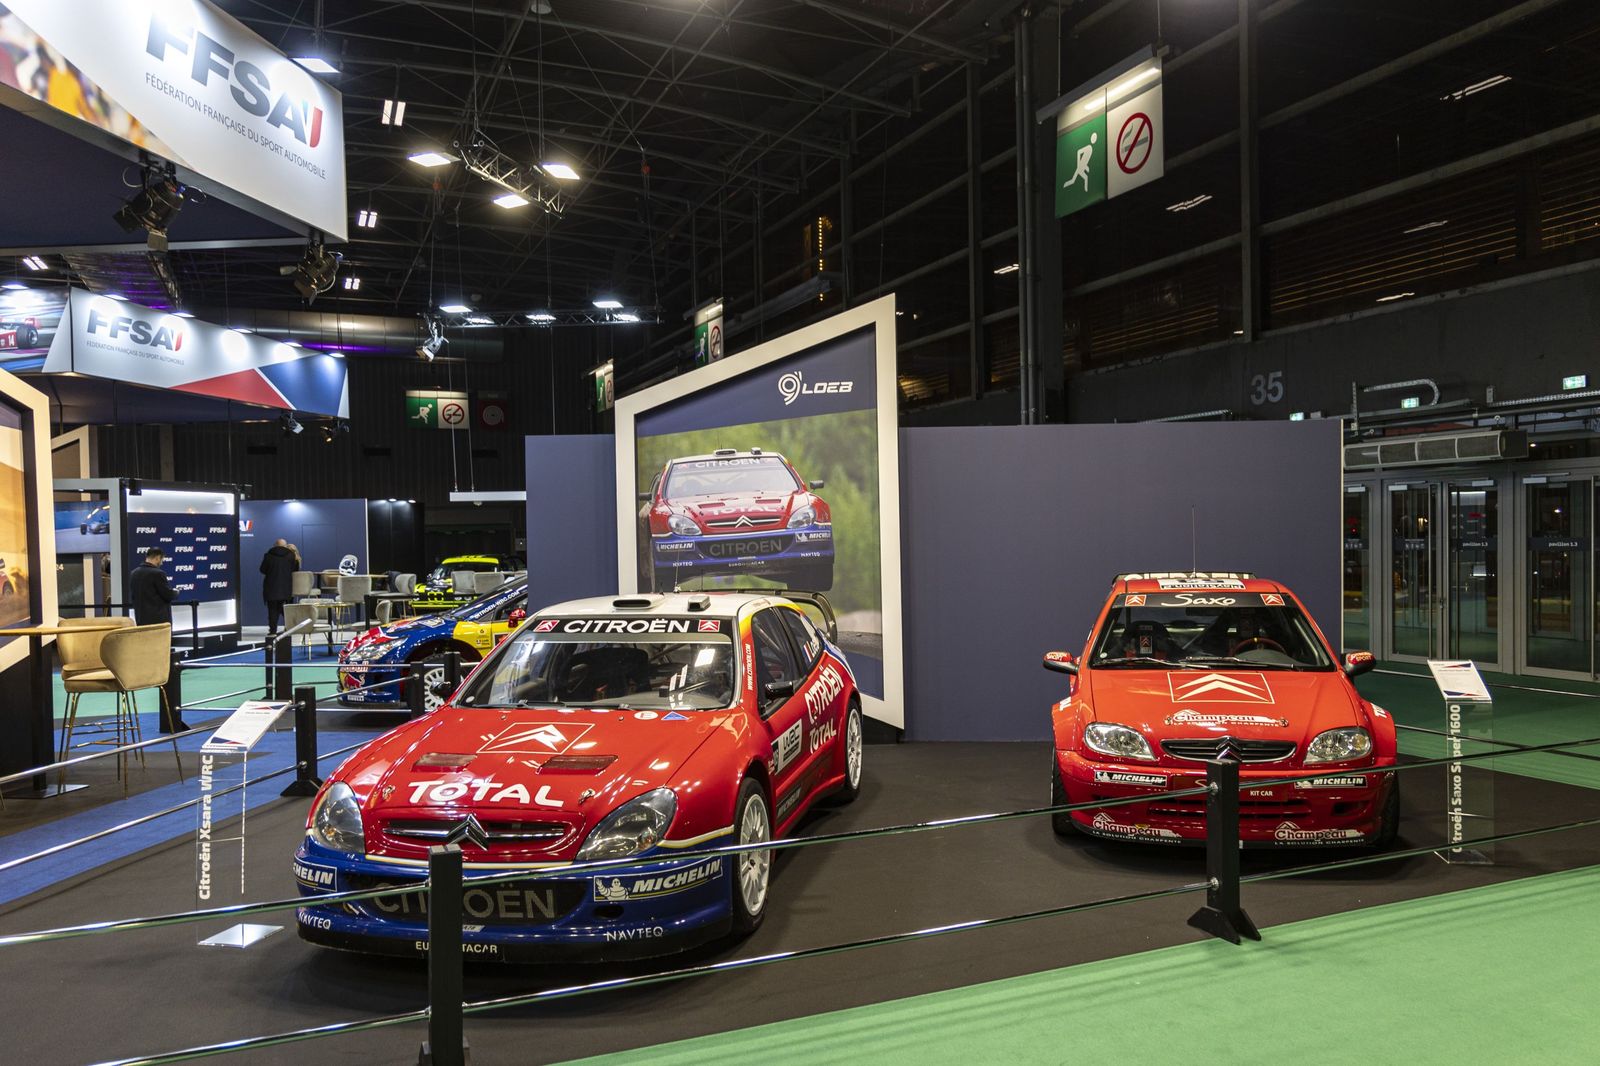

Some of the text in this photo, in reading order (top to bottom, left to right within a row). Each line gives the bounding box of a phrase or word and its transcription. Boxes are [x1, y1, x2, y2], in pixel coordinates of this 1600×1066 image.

[145, 12, 322, 147] FFSA
[145, 72, 327, 179] FÉDÉRATION FRANÇAISE DU SPORT AUTOMOBILE
[87, 309, 183, 351] FFSA
[802, 381, 853, 394] LOEB
[1250, 371, 1284, 405] 35
[175, 545, 194, 553] FFSA
[210, 581, 228, 589] FFSA
[1161, 593, 1236, 607] Saxo
[563, 618, 691, 634] CITROËN
[184, 650, 189, 658] 2
[804, 664, 844, 724] CITROËN
[1174, 714, 1256, 725] Champeau
[1450, 704, 1461, 735] 1600
[809, 718, 837, 754] TOTAL
[1112, 773, 1167, 784] MICHELIN
[1312, 777, 1364, 785] MICHELIN
[408, 780, 564, 807] TOTAL
[1451, 775, 1462, 806] Saxo
[199, 755, 213, 900] Citroën Xsara WRC
[1093, 820, 1161, 837] Champeau
[1275, 829, 1347, 842] Champeau
[632, 859, 721, 893] MICHELIN
[298, 911, 331, 930] NAVTEQ
[606, 926, 664, 941] NAVTEQ
